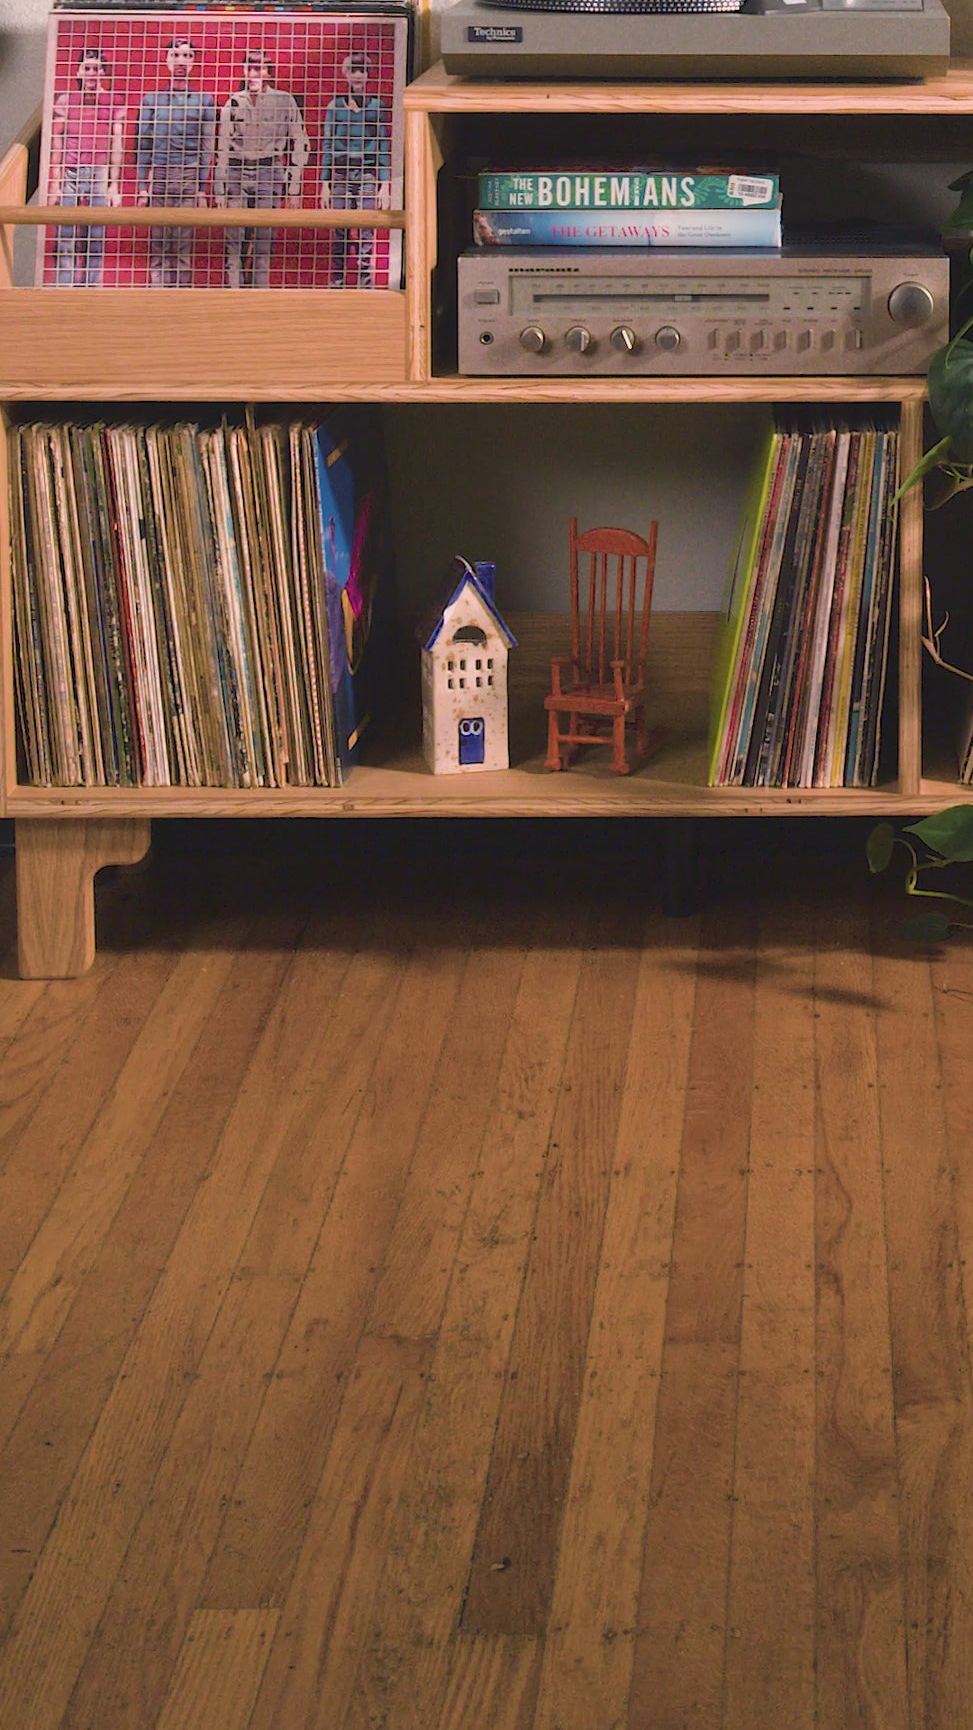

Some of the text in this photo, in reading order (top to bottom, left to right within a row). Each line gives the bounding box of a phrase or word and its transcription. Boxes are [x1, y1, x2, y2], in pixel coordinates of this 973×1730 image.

[473, 27, 516, 36] Technics
[513, 178, 533, 190] THE
[538, 176, 695, 207] BOHEMIANS
[509, 193, 533, 205] NEW
[550, 225, 671, 238] THE GETAWAYS
